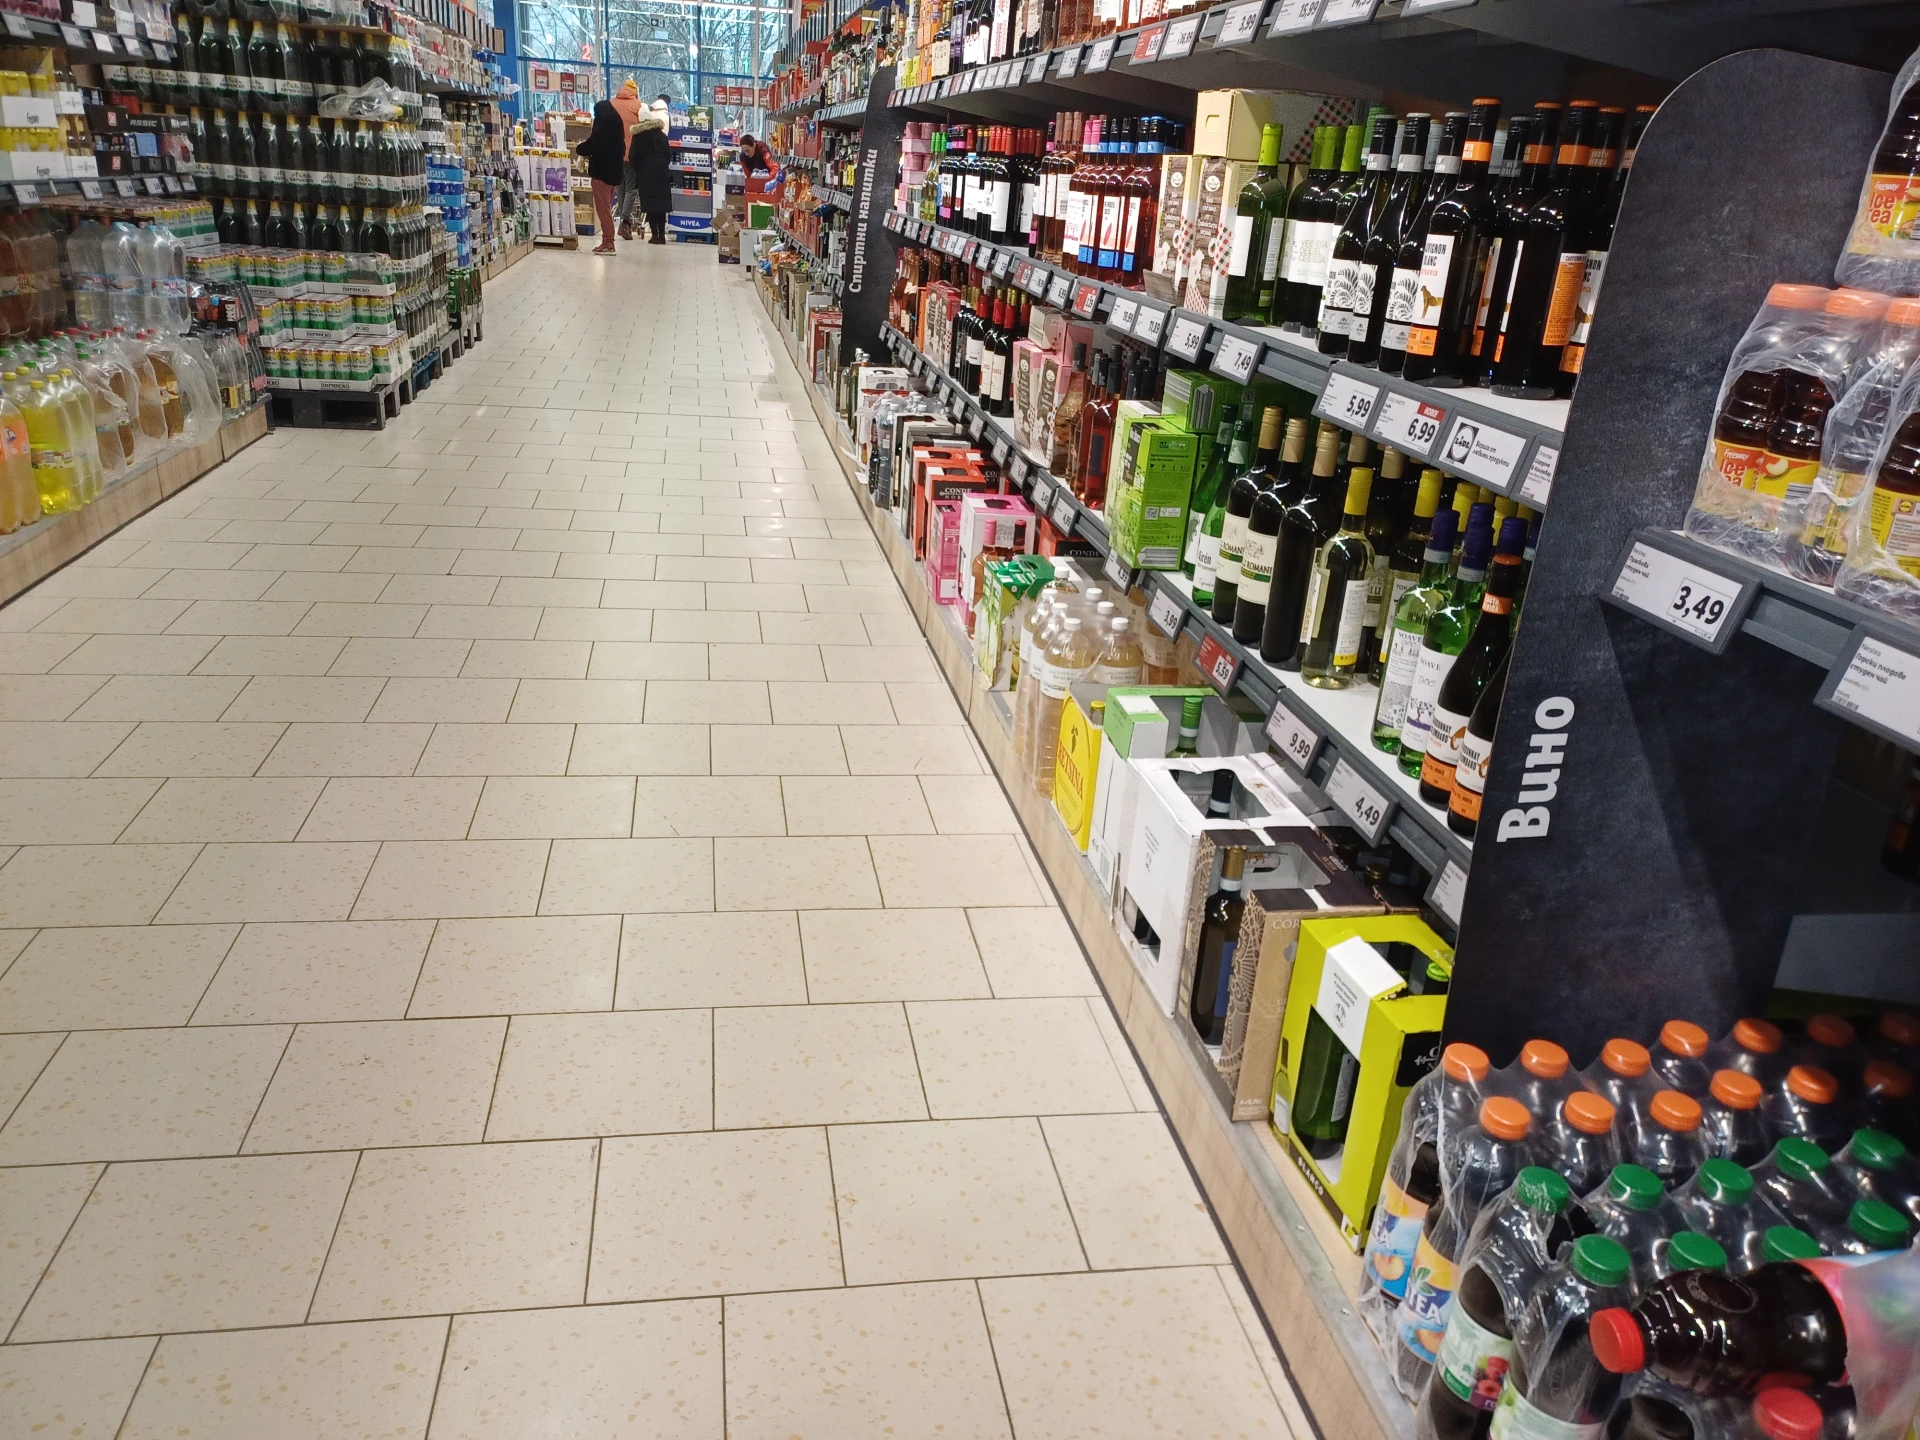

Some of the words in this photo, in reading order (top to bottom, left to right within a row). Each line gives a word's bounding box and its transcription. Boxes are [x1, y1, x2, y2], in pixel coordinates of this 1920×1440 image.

[1238, 14, 1258, 33] 3,99
[582, 44, 591, 60] 2
[858, 149, 877, 220] напитки
[1870, 191, 1897, 210] Ice
[680, 219, 701, 227] NIVEA
[849, 222, 868, 293] Спиртни
[1184, 332, 1200, 351] 5,99
[1234, 352, 1252, 371] 7,49
[320, 381, 351, 389] ПИРИНСКО
[1346, 394, 1371, 418] 5,99
[1407, 418, 1436, 443] 6,99
[1488, 455, 1510, 468] продукти
[1723, 448, 1750, 461] Freeway
[1719, 458, 1748, 477] Ice
[1624, 564, 1641, 575] студен
[1629, 555, 1650, 569] Праскова
[1673, 585, 1725, 625] 3,49
[1164, 610, 1178, 630] 3,99
[1861, 643, 1882, 657] Nestea
[1215, 661, 1230, 680] 5,59
[1420, 657, 1442, 672] SOAVE
[1850, 663, 1875, 679] студен
[1875, 674, 1889, 685] чай
[1855, 653, 1878, 669] Горски
[1877, 664, 1907, 681] плодове
[1289, 732, 1311, 759] 9,99
[1057, 740, 1084, 800] RETSINA
[1496, 696, 1575, 843] Вино
[1355, 797, 1380, 826] 4,49
[1297, 1156, 1324, 1196] BLANCO
